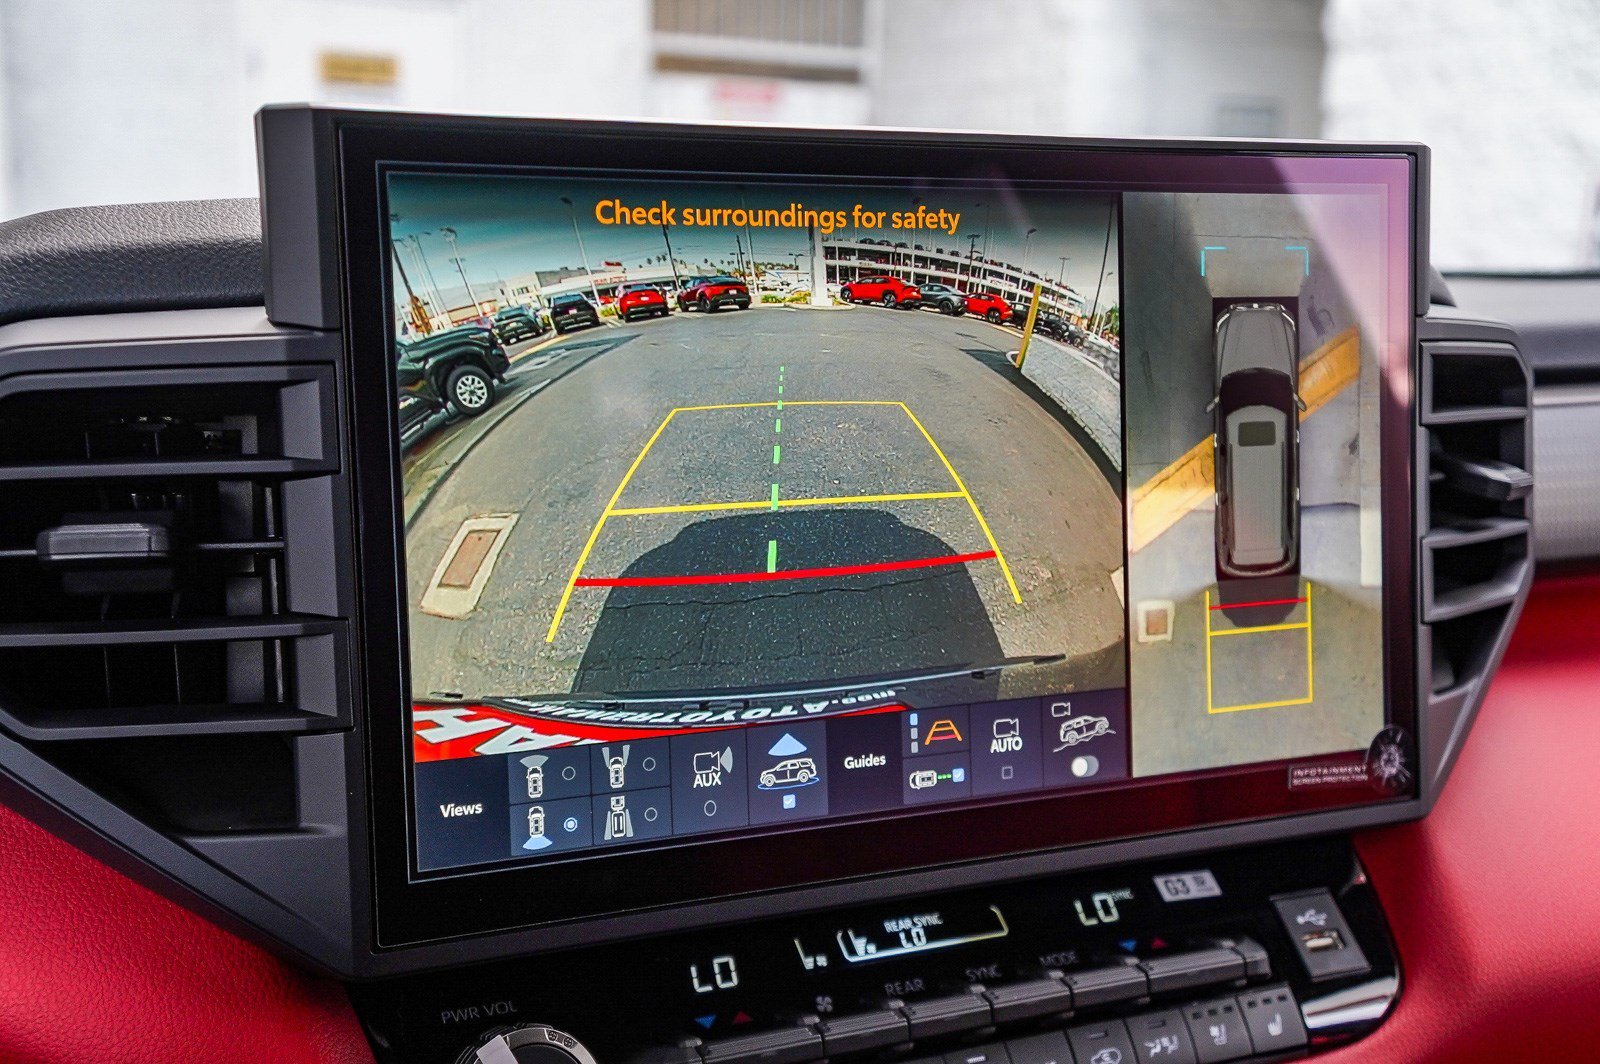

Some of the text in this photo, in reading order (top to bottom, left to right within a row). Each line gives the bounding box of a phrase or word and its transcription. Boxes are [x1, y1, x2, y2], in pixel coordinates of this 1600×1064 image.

[595, 199, 961, 235] Check surroundings for safety
[990, 736, 1023, 754] AUTO
[844, 753, 887, 770] Guides
[693, 772, 722, 789] AUX
[440, 802, 483, 818] Views
[883, 912, 944, 933] REAR SYNC
[1039, 951, 1079, 968] MODE
[965, 965, 1001, 982] SYNC
[884, 978, 925, 996] REAR
[441, 1001, 518, 1024] PWR VOL
